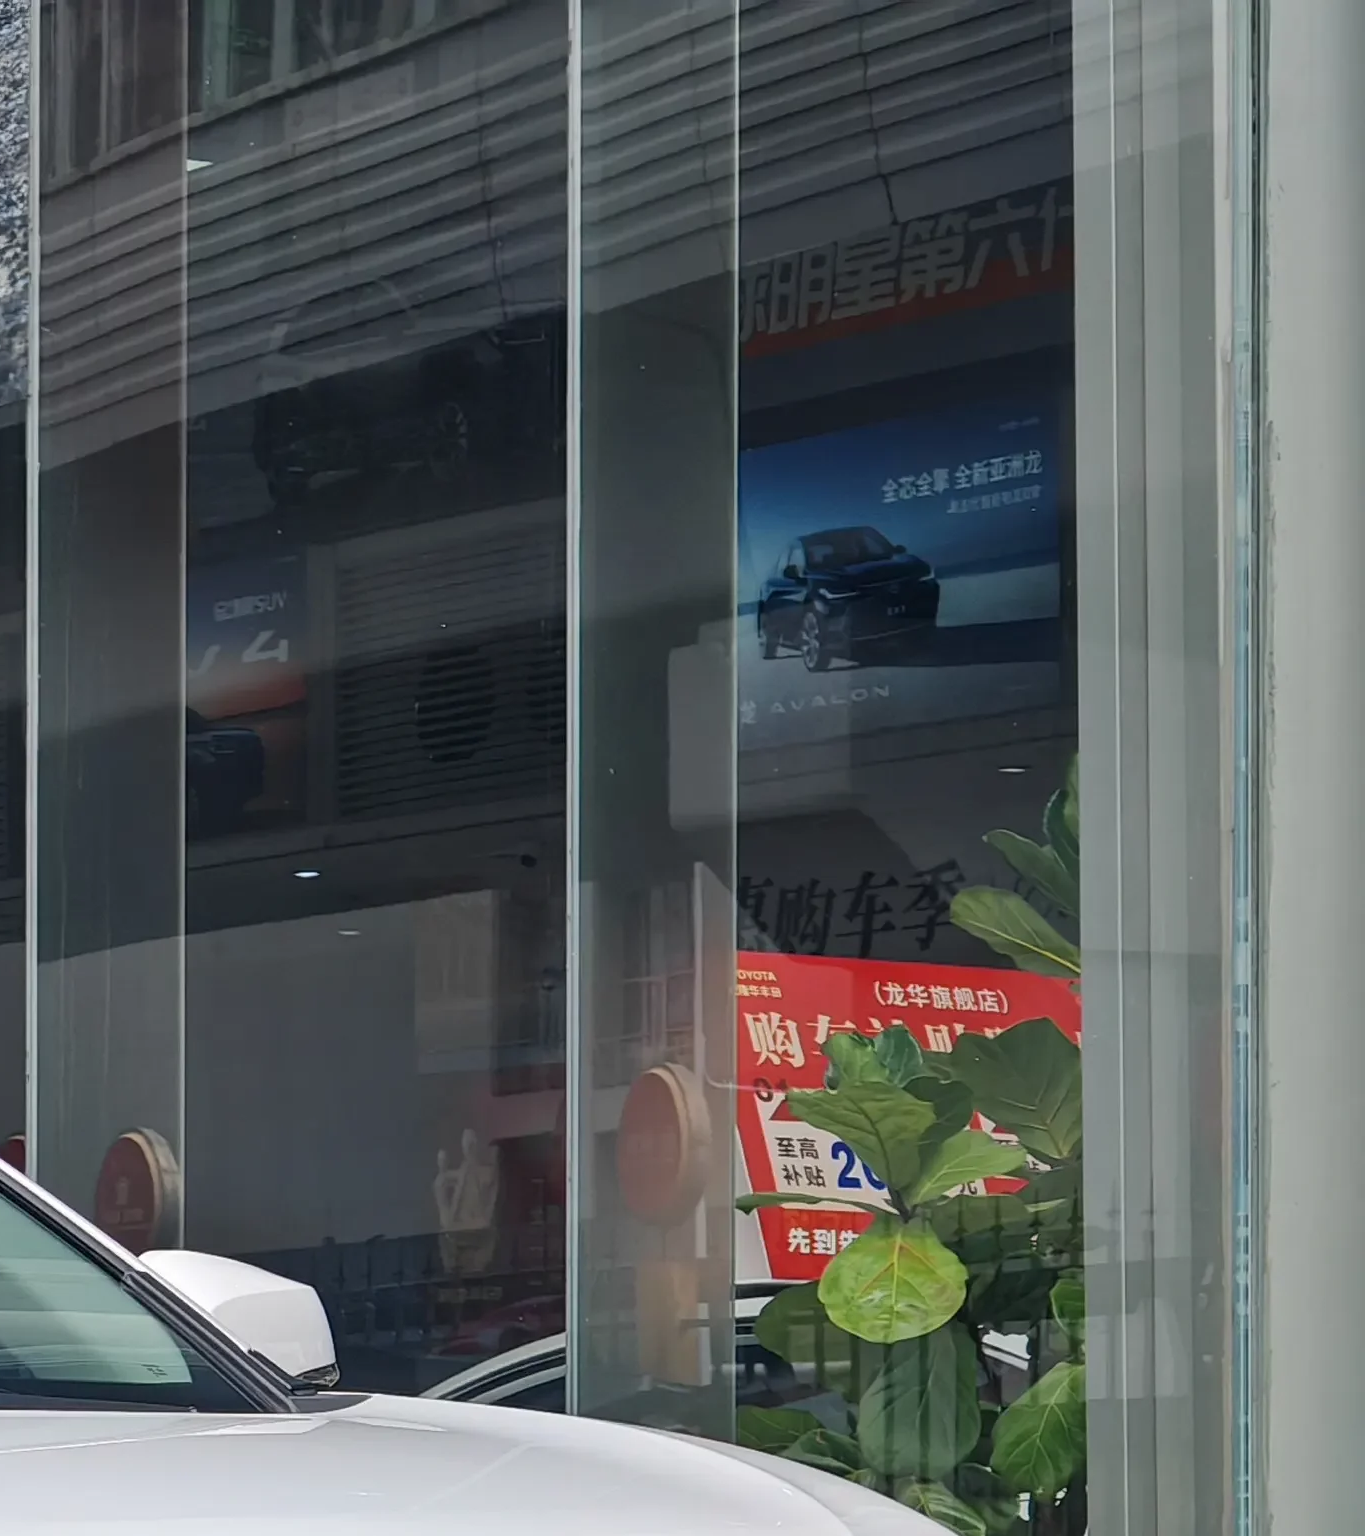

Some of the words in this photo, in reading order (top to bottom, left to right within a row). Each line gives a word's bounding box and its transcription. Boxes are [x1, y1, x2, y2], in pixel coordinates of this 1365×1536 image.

[770, 684, 890, 715] AVALON
[736, 968, 777, 982] OYOTA
[775, 1136, 820, 1160] 至高
[781, 1165, 827, 1188] 补贴
